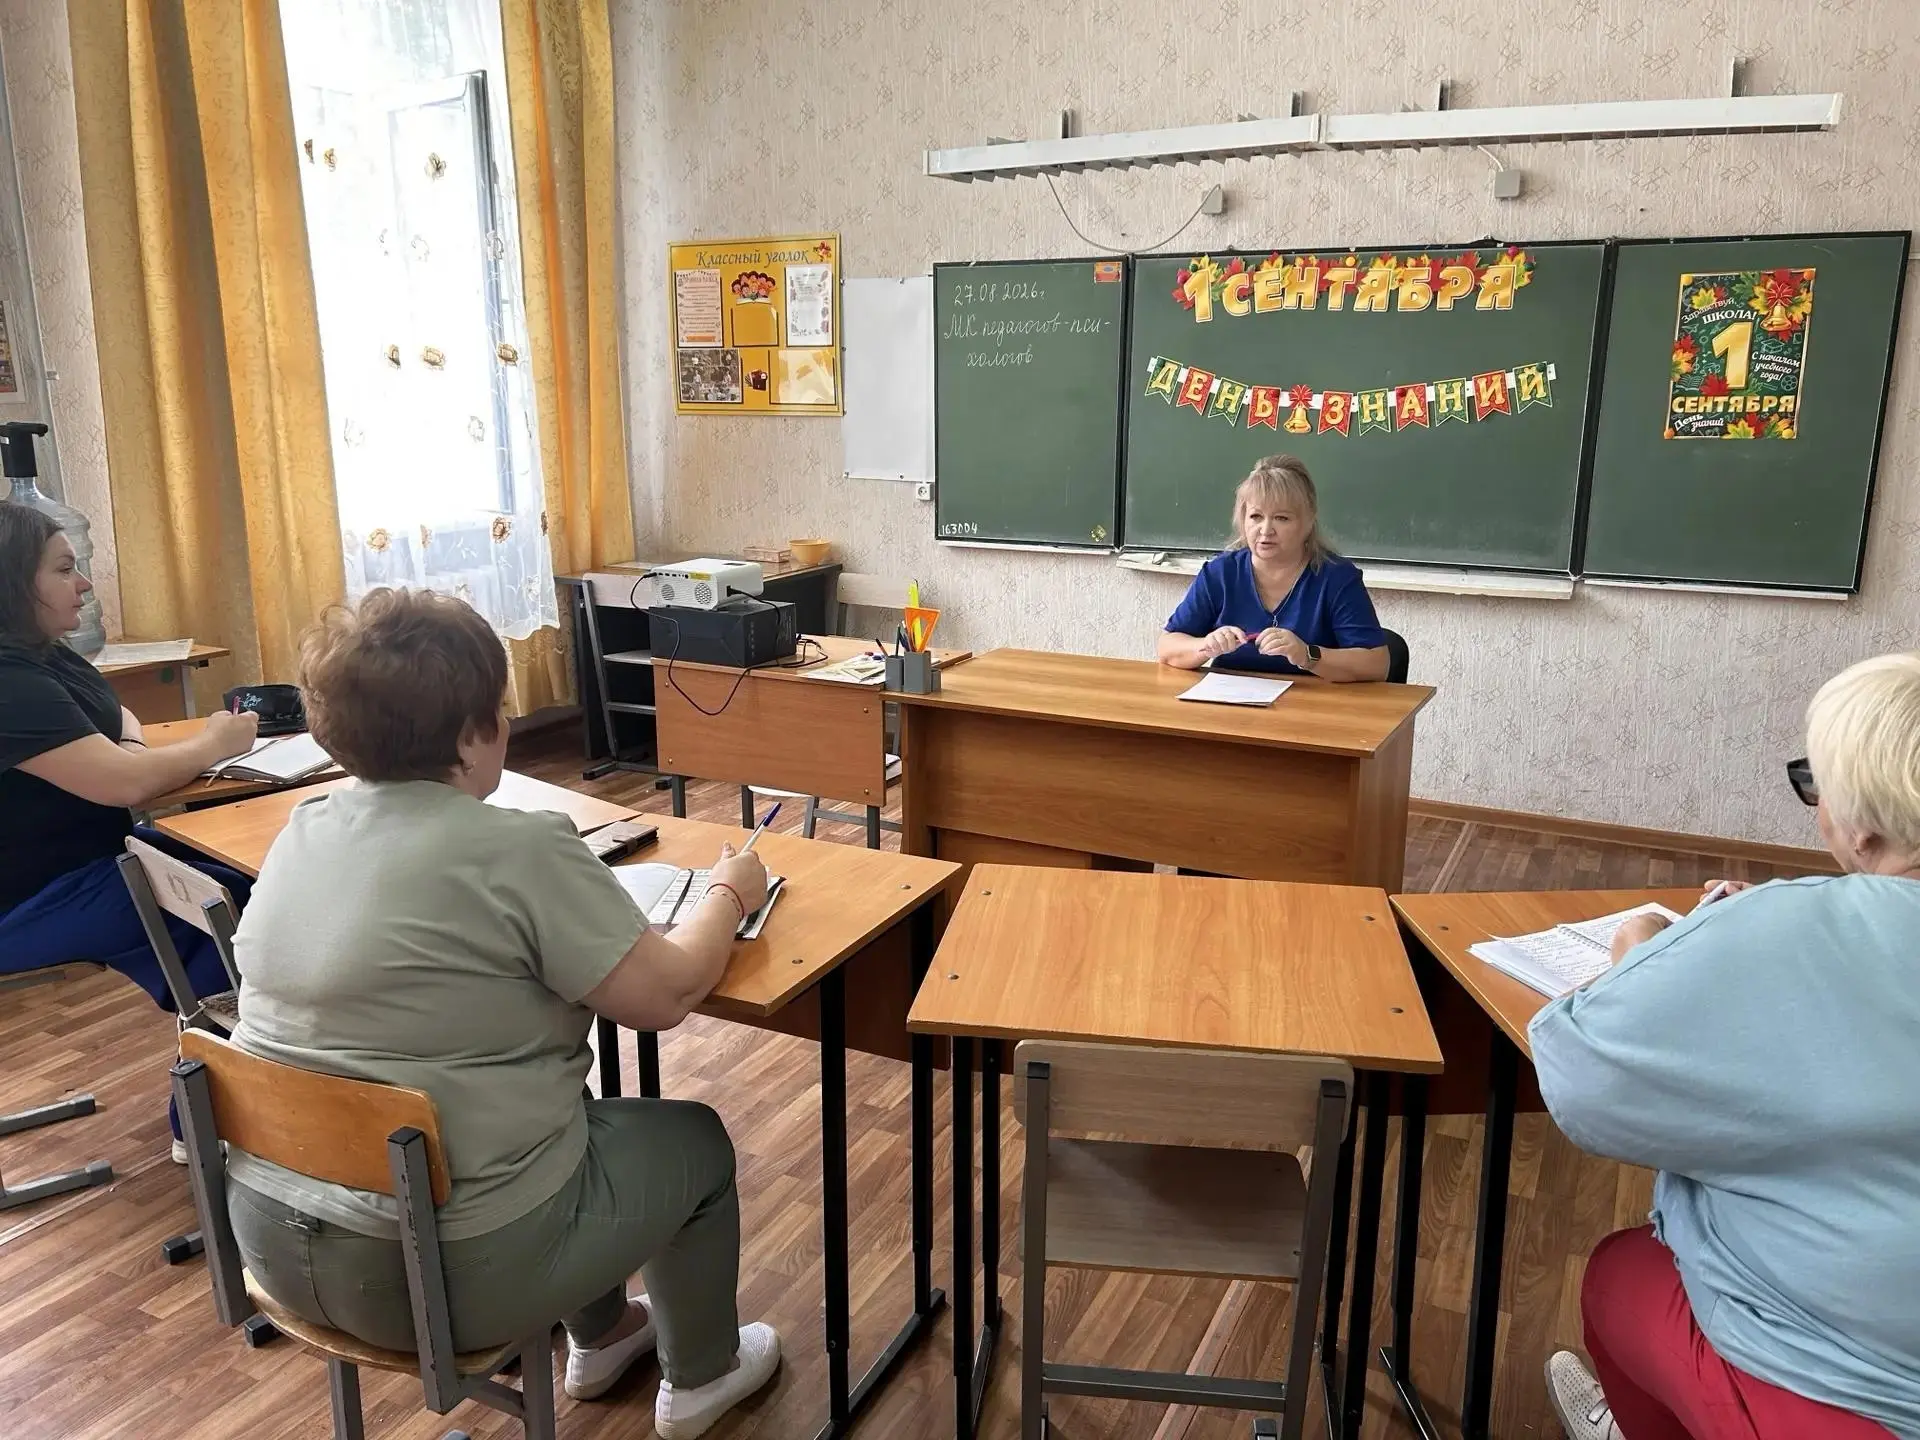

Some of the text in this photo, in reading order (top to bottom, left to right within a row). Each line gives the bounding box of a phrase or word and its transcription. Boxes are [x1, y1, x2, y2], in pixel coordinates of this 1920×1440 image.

[696, 249, 810, 268] Классный уголок
[1184, 265, 1518, 322] 1 СЕНТЯБРЯ
[1702, 309, 1758, 325] ШКОЛА!
[1712, 321, 1753, 389] 1
[1751, 351, 1801, 368] С началом
[1754, 362, 1793, 374] учебного
[1760, 371, 1784, 383] года!
[1151, 363, 1546, 425] ДЕНЬ ЗНАНИЙ
[1671, 395, 1795, 413] СЕНТЯБРЯ
[1674, 413, 1704, 431] День
[1691, 418, 1724, 433] знаний
